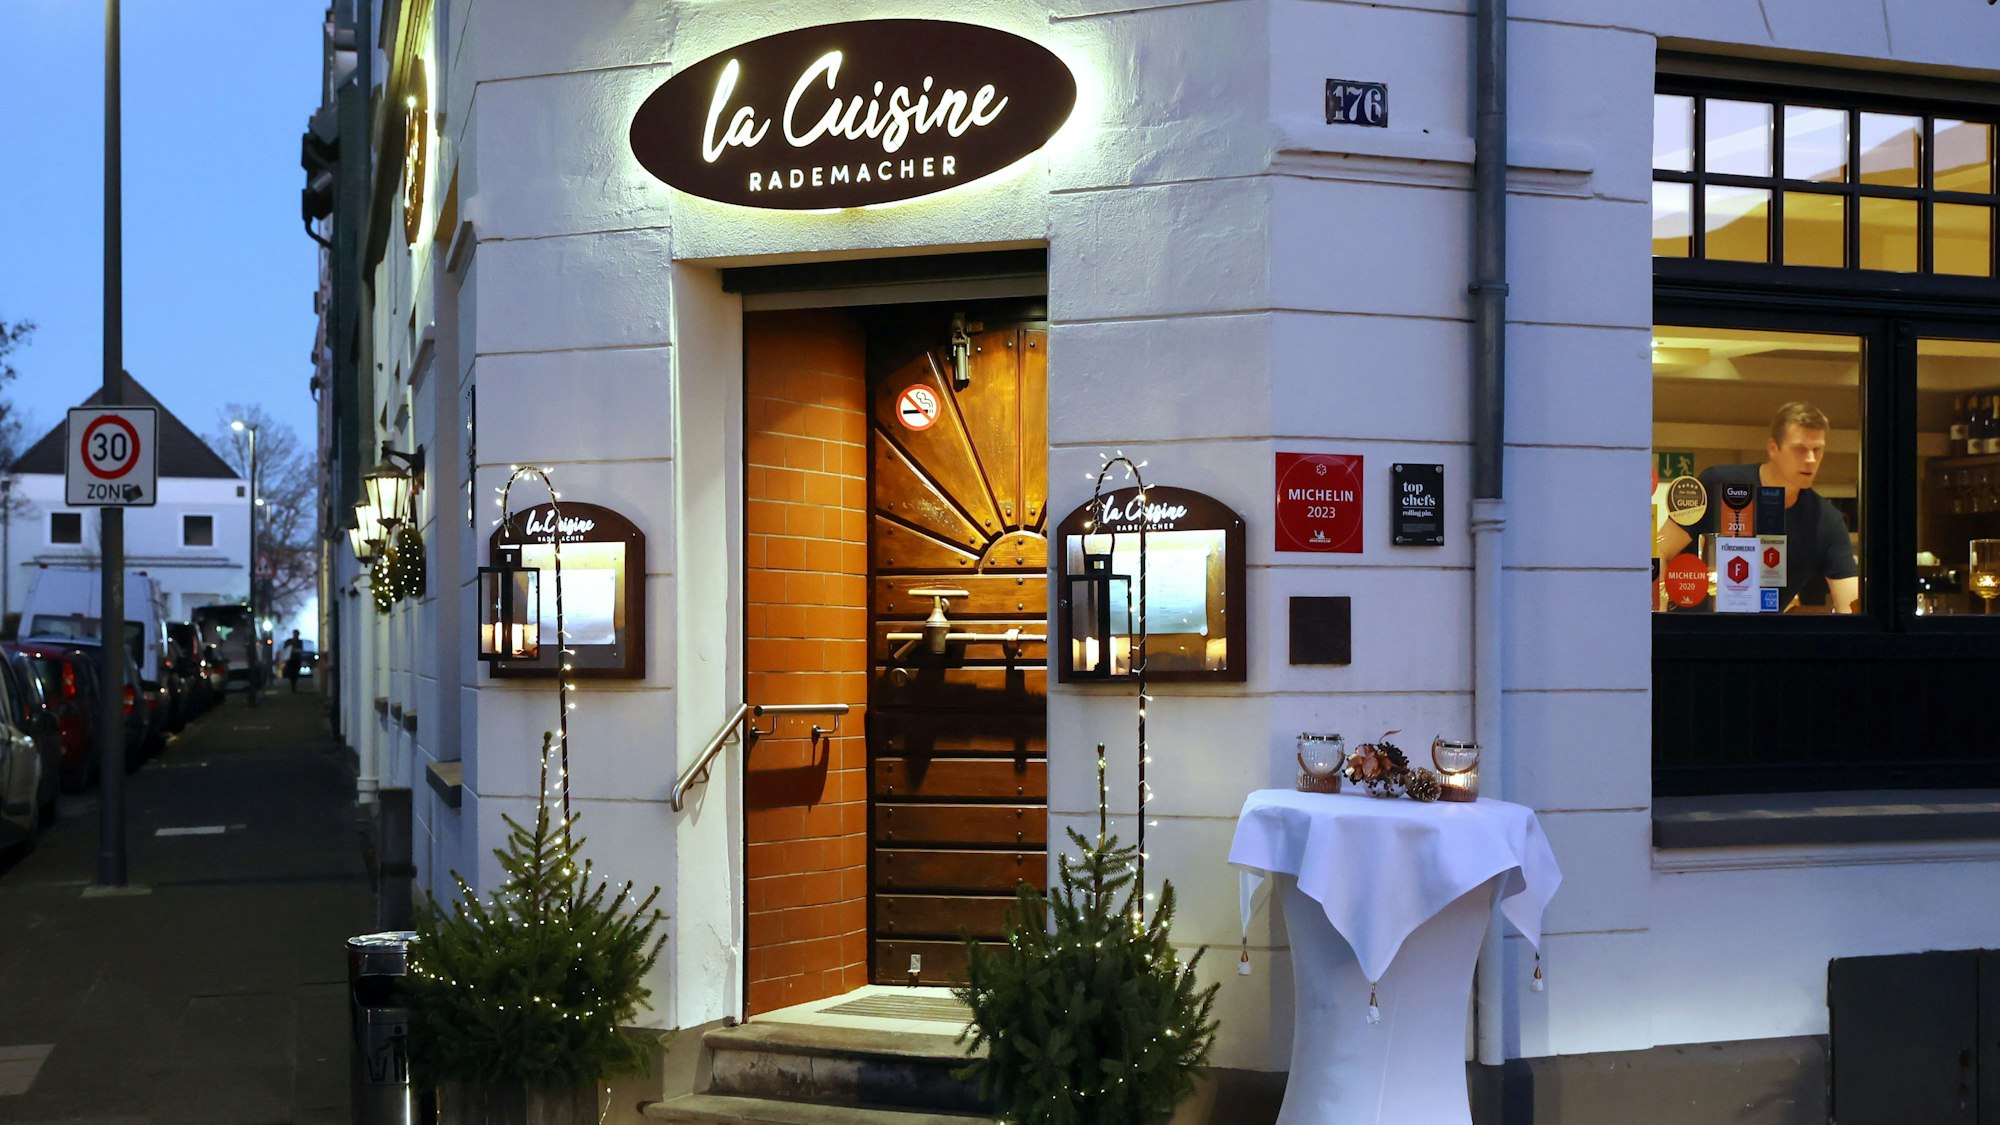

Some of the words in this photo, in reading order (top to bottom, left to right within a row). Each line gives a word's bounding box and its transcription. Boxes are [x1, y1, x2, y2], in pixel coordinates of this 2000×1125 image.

[702, 59, 771, 163] la
[783, 51, 1008, 153] Cuisine
[1333, 86, 1382, 123] 176
[749, 155, 956, 192] RADEMACHER
[93, 433, 126, 461] 30
[1403, 481, 1423, 495] top
[1727, 487, 1748, 496] Gusto
[1288, 488, 1354, 502] MICHELIN
[1402, 494, 1436, 506] chefs
[1677, 499, 1699, 507] GUIDE
[1307, 506, 1336, 518] 2023
[1116, 522, 1174, 531] RADEACHER
[1728, 523, 1745, 531] 2021
[1668, 571, 1706, 580] MICHELIN
[1678, 583, 1696, 591] 2020
